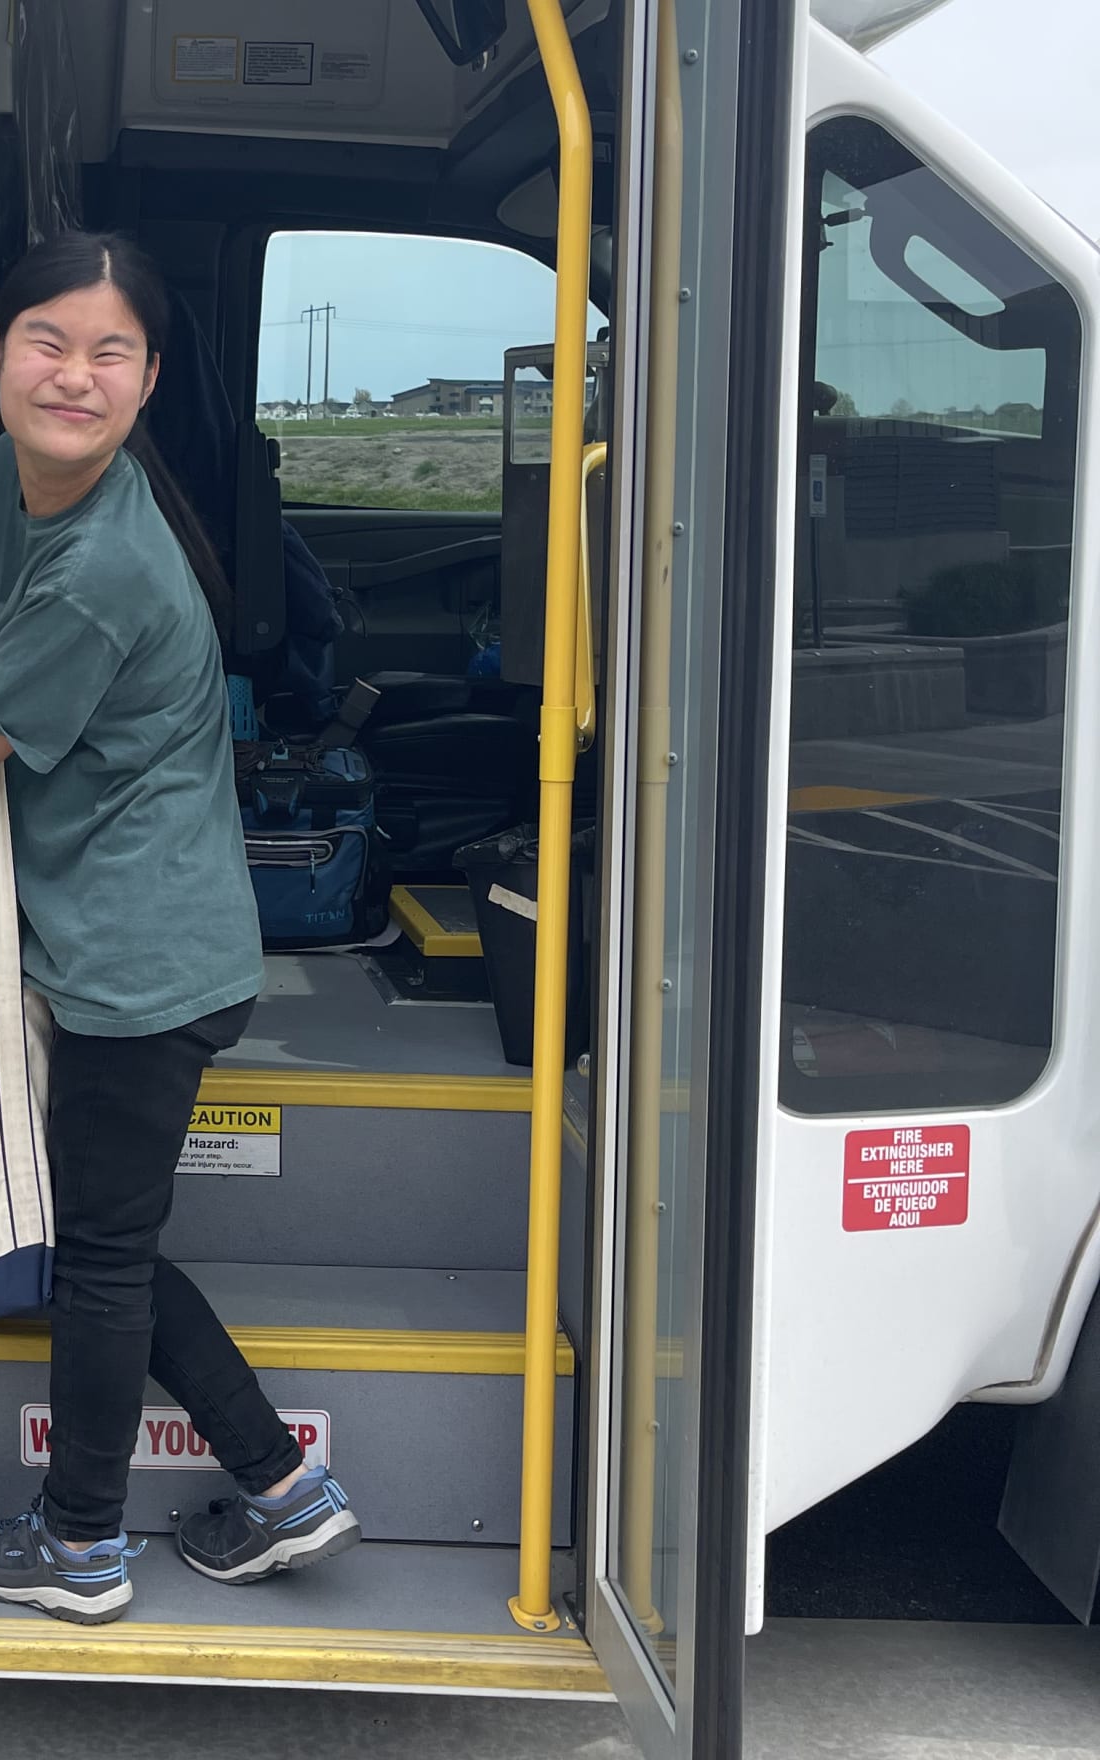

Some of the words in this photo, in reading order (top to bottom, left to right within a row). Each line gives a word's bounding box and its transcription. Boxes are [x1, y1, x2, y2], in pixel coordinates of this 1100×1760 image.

[305, 909, 345, 924] TITAN
[189, 1137, 239, 1149] Hazard:
[893, 1129, 923, 1144] FIRE
[861, 1142, 954, 1162] EXTINGUISHER
[890, 1159, 924, 1175] HERE
[863, 1180, 949, 1199] EXTINGUIDOR
[874, 1198, 891, 1213] DE
[895, 1196, 937, 1212] FUEGO
[889, 1212, 920, 1227] AQUI
[145, 1420, 213, 1457] YOU
